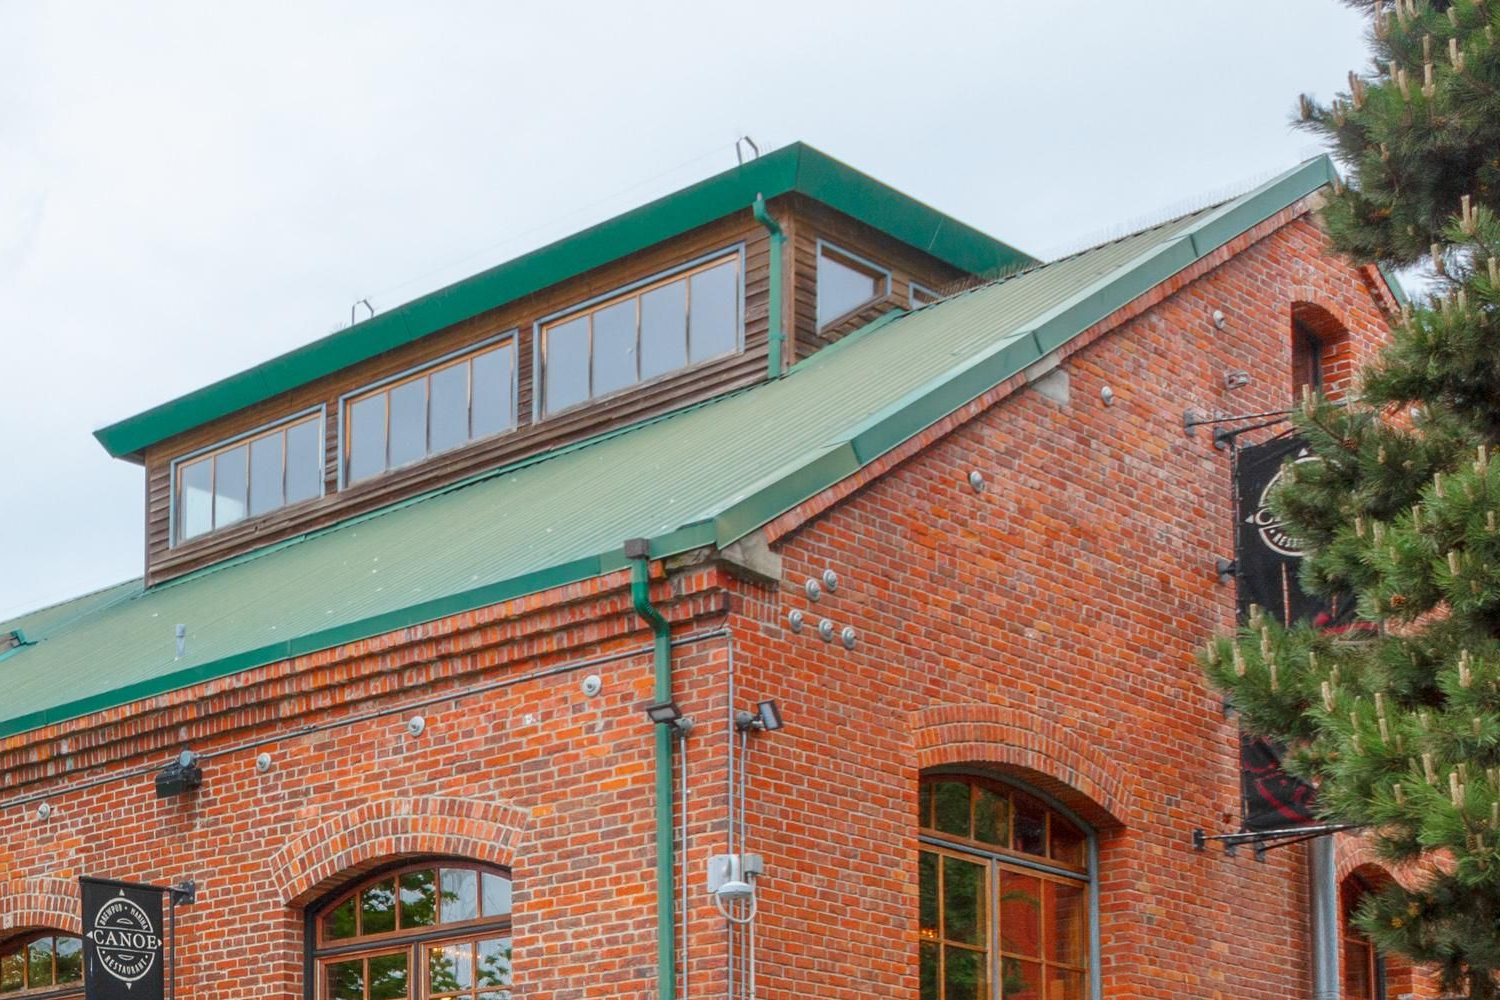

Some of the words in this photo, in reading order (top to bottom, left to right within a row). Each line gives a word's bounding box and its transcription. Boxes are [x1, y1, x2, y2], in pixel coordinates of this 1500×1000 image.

[99, 903, 123, 926] BREWPUB
[93, 929, 158, 950] CANOE
[104, 954, 148, 976] RESTAURANT
